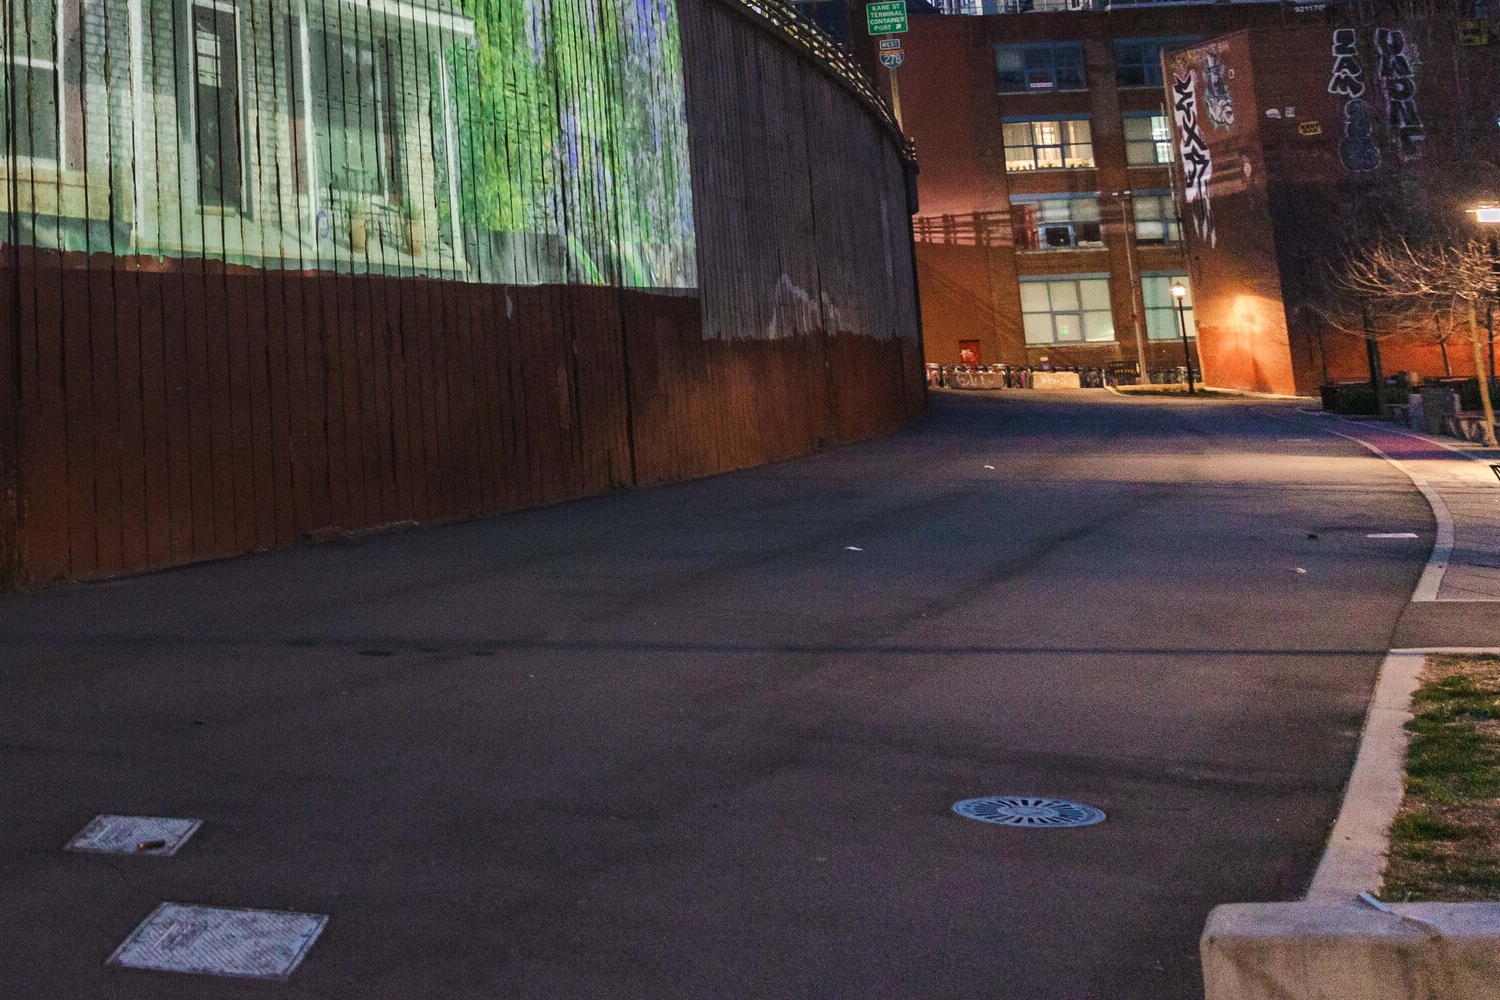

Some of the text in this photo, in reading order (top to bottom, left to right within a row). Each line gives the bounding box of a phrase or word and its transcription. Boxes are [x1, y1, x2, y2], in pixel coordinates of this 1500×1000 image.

[870, 10, 903, 18] TERMINAL
[870, 17, 905, 25] CONTAINER
[884, 54, 902, 65] 278
